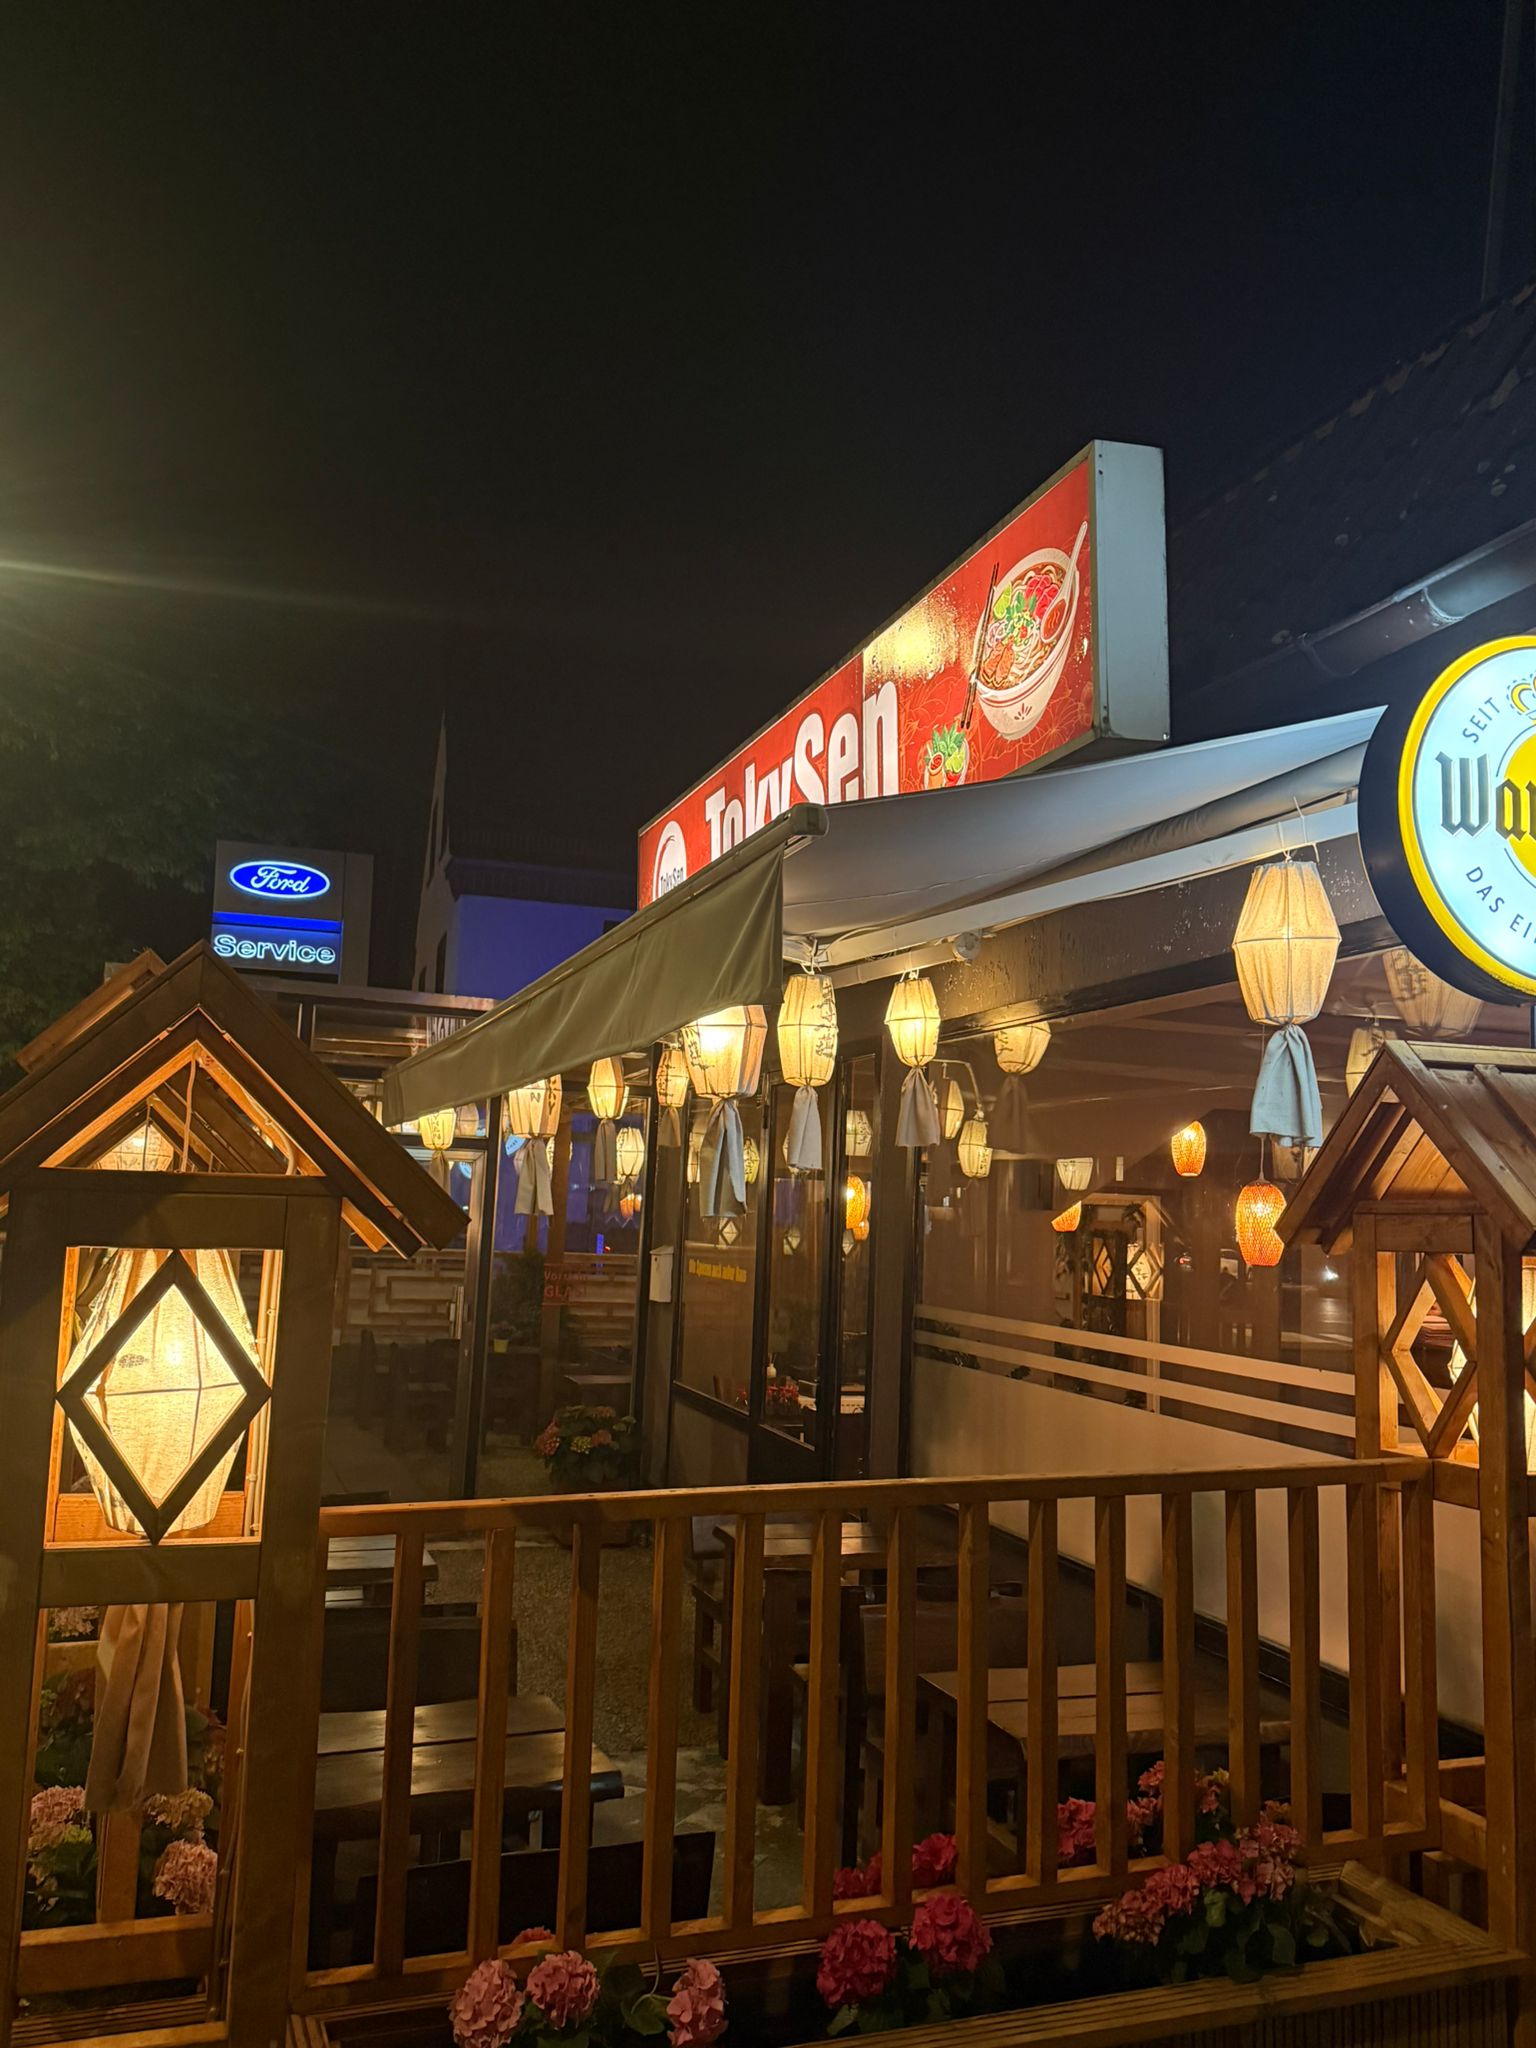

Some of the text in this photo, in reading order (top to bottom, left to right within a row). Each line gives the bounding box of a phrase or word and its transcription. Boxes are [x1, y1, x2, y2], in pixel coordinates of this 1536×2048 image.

[1462, 697, 1500, 743] SEIT
[250, 866, 311, 893] Ford
[1466, 866, 1536, 945] DAS EI
[213, 934, 336, 964] Service
